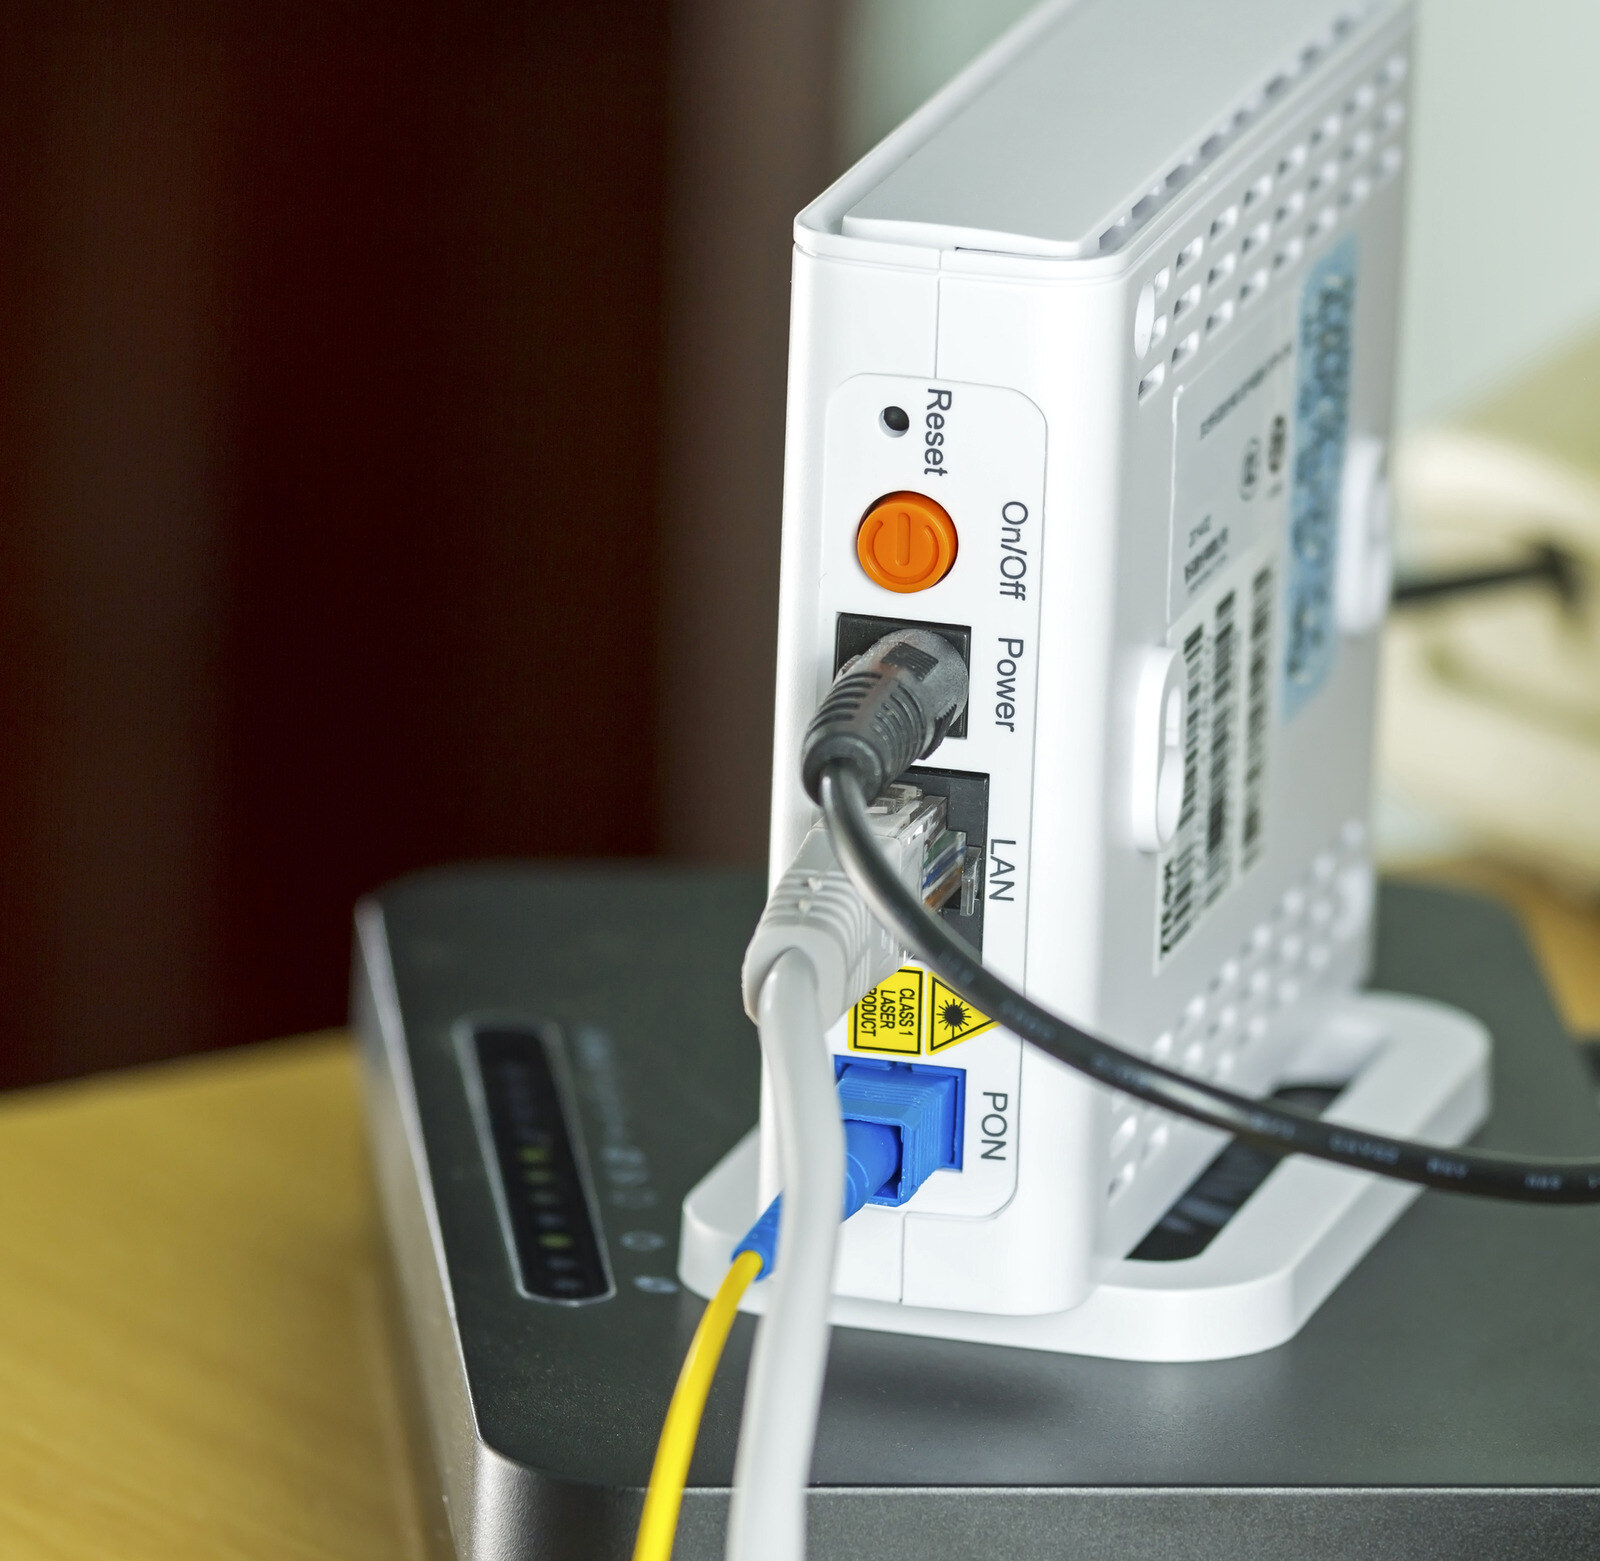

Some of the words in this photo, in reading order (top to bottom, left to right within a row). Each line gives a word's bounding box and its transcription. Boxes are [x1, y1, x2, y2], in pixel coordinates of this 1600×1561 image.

[924, 388, 952, 476] Reset
[999, 501, 1029, 601] On/Off
[995, 637, 1024, 733] Power
[988, 838, 1016, 902] LAN
[880, 989, 896, 1029] LASER
[899, 988, 915, 1027] CLASS
[981, 1091, 1008, 1161] PON
